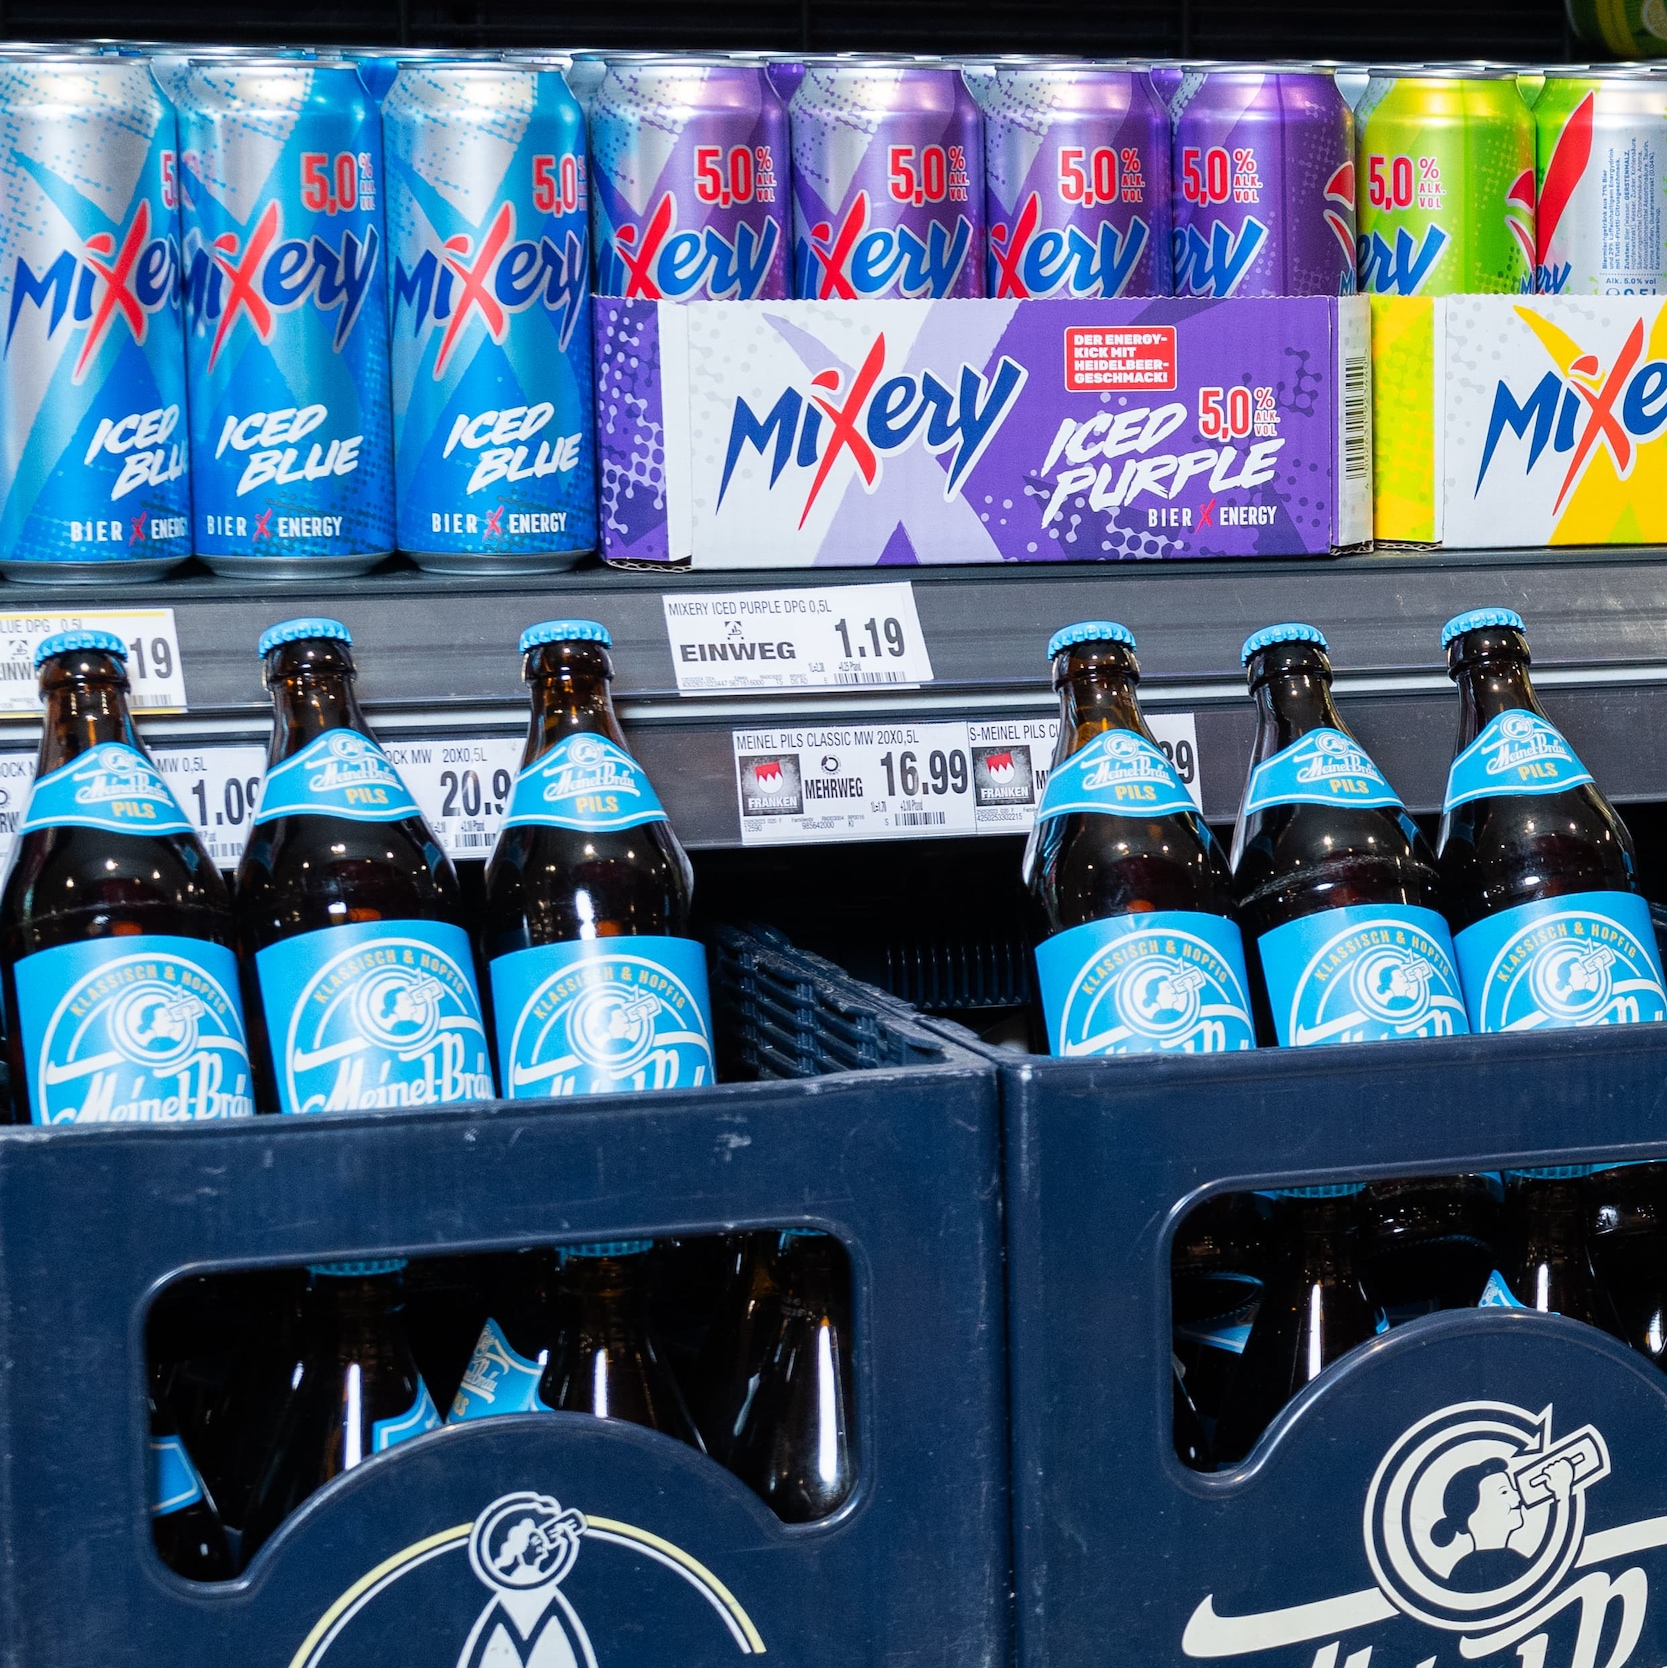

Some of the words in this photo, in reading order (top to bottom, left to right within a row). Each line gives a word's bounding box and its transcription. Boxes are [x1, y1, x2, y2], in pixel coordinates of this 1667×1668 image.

[889, 144, 947, 205] 5,0
[1059, 145, 1119, 205] 5,0
[1182, 144, 1232, 205] 5,0
[1368, 155, 1413, 211] 5,0
[1418, 196, 1443, 211] VOL
[1073, 333, 1102, 346] DER
[1104, 333, 1169, 347] ENERGY-
[1073, 345, 1108, 358] KICK
[1110, 345, 1138, 358] MIT
[1073, 358, 1171, 371] HEIDELBEER-
[1073, 371, 1170, 384] GESCHMACK!
[1197, 386, 1251, 440] 5,0
[85, 404, 181, 465] ICED
[214, 404, 327, 459] ICED
[443, 402, 556, 460] ICED
[1042, 402, 1187, 470] ICED
[235, 433, 364, 498] BLUE
[466, 432, 582, 495] BLUE
[1041, 438, 1286, 530] PURPLE
[207, 516, 248, 537] BIER
[277, 516, 342, 538] ENERGY
[431, 512, 475, 536] BIER
[509, 511, 567, 536] ENERGY
[1147, 507, 1193, 529] BIER
[1218, 505, 1277, 527] ENERGY
[71, 520, 123, 542] BIER
[668, 602, 709, 616] MIXERY
[711, 601, 738, 616] ICED
[740, 600, 782, 615] PURPLE
[784, 599, 808, 614] DPG
[809, 599, 833, 615] 0,5L
[27, 619, 51, 633] DPG
[834, 616, 906, 659] 1.19
[679, 641, 797, 663] EINWEG
[736, 734, 779, 751] MEINEL
[780, 733, 804, 749] PILS
[806, 731, 852, 748] CLASSIC
[854, 731, 875, 746] MW
[876, 729, 920, 747] 20X0,5L
[968, 725, 1022, 742] S-MEINEL
[1022, 724, 1047, 740] PILS
[157, 757, 179, 774] MW
[182, 756, 208, 773] 0,5L
[411, 748, 432, 763] MW
[442, 746, 488, 763] 20X0,5L
[880, 749, 969, 797] 16.99
[1517, 762, 1559, 780] PILS
[804, 776, 864, 800] MEHRWEG
[980, 786, 1030, 800] FRANKEN
[1329, 777, 1371, 796] PILS
[747, 796, 798, 809] FRANKEN
[1495, 923, 1568, 983] KLASSISCH
